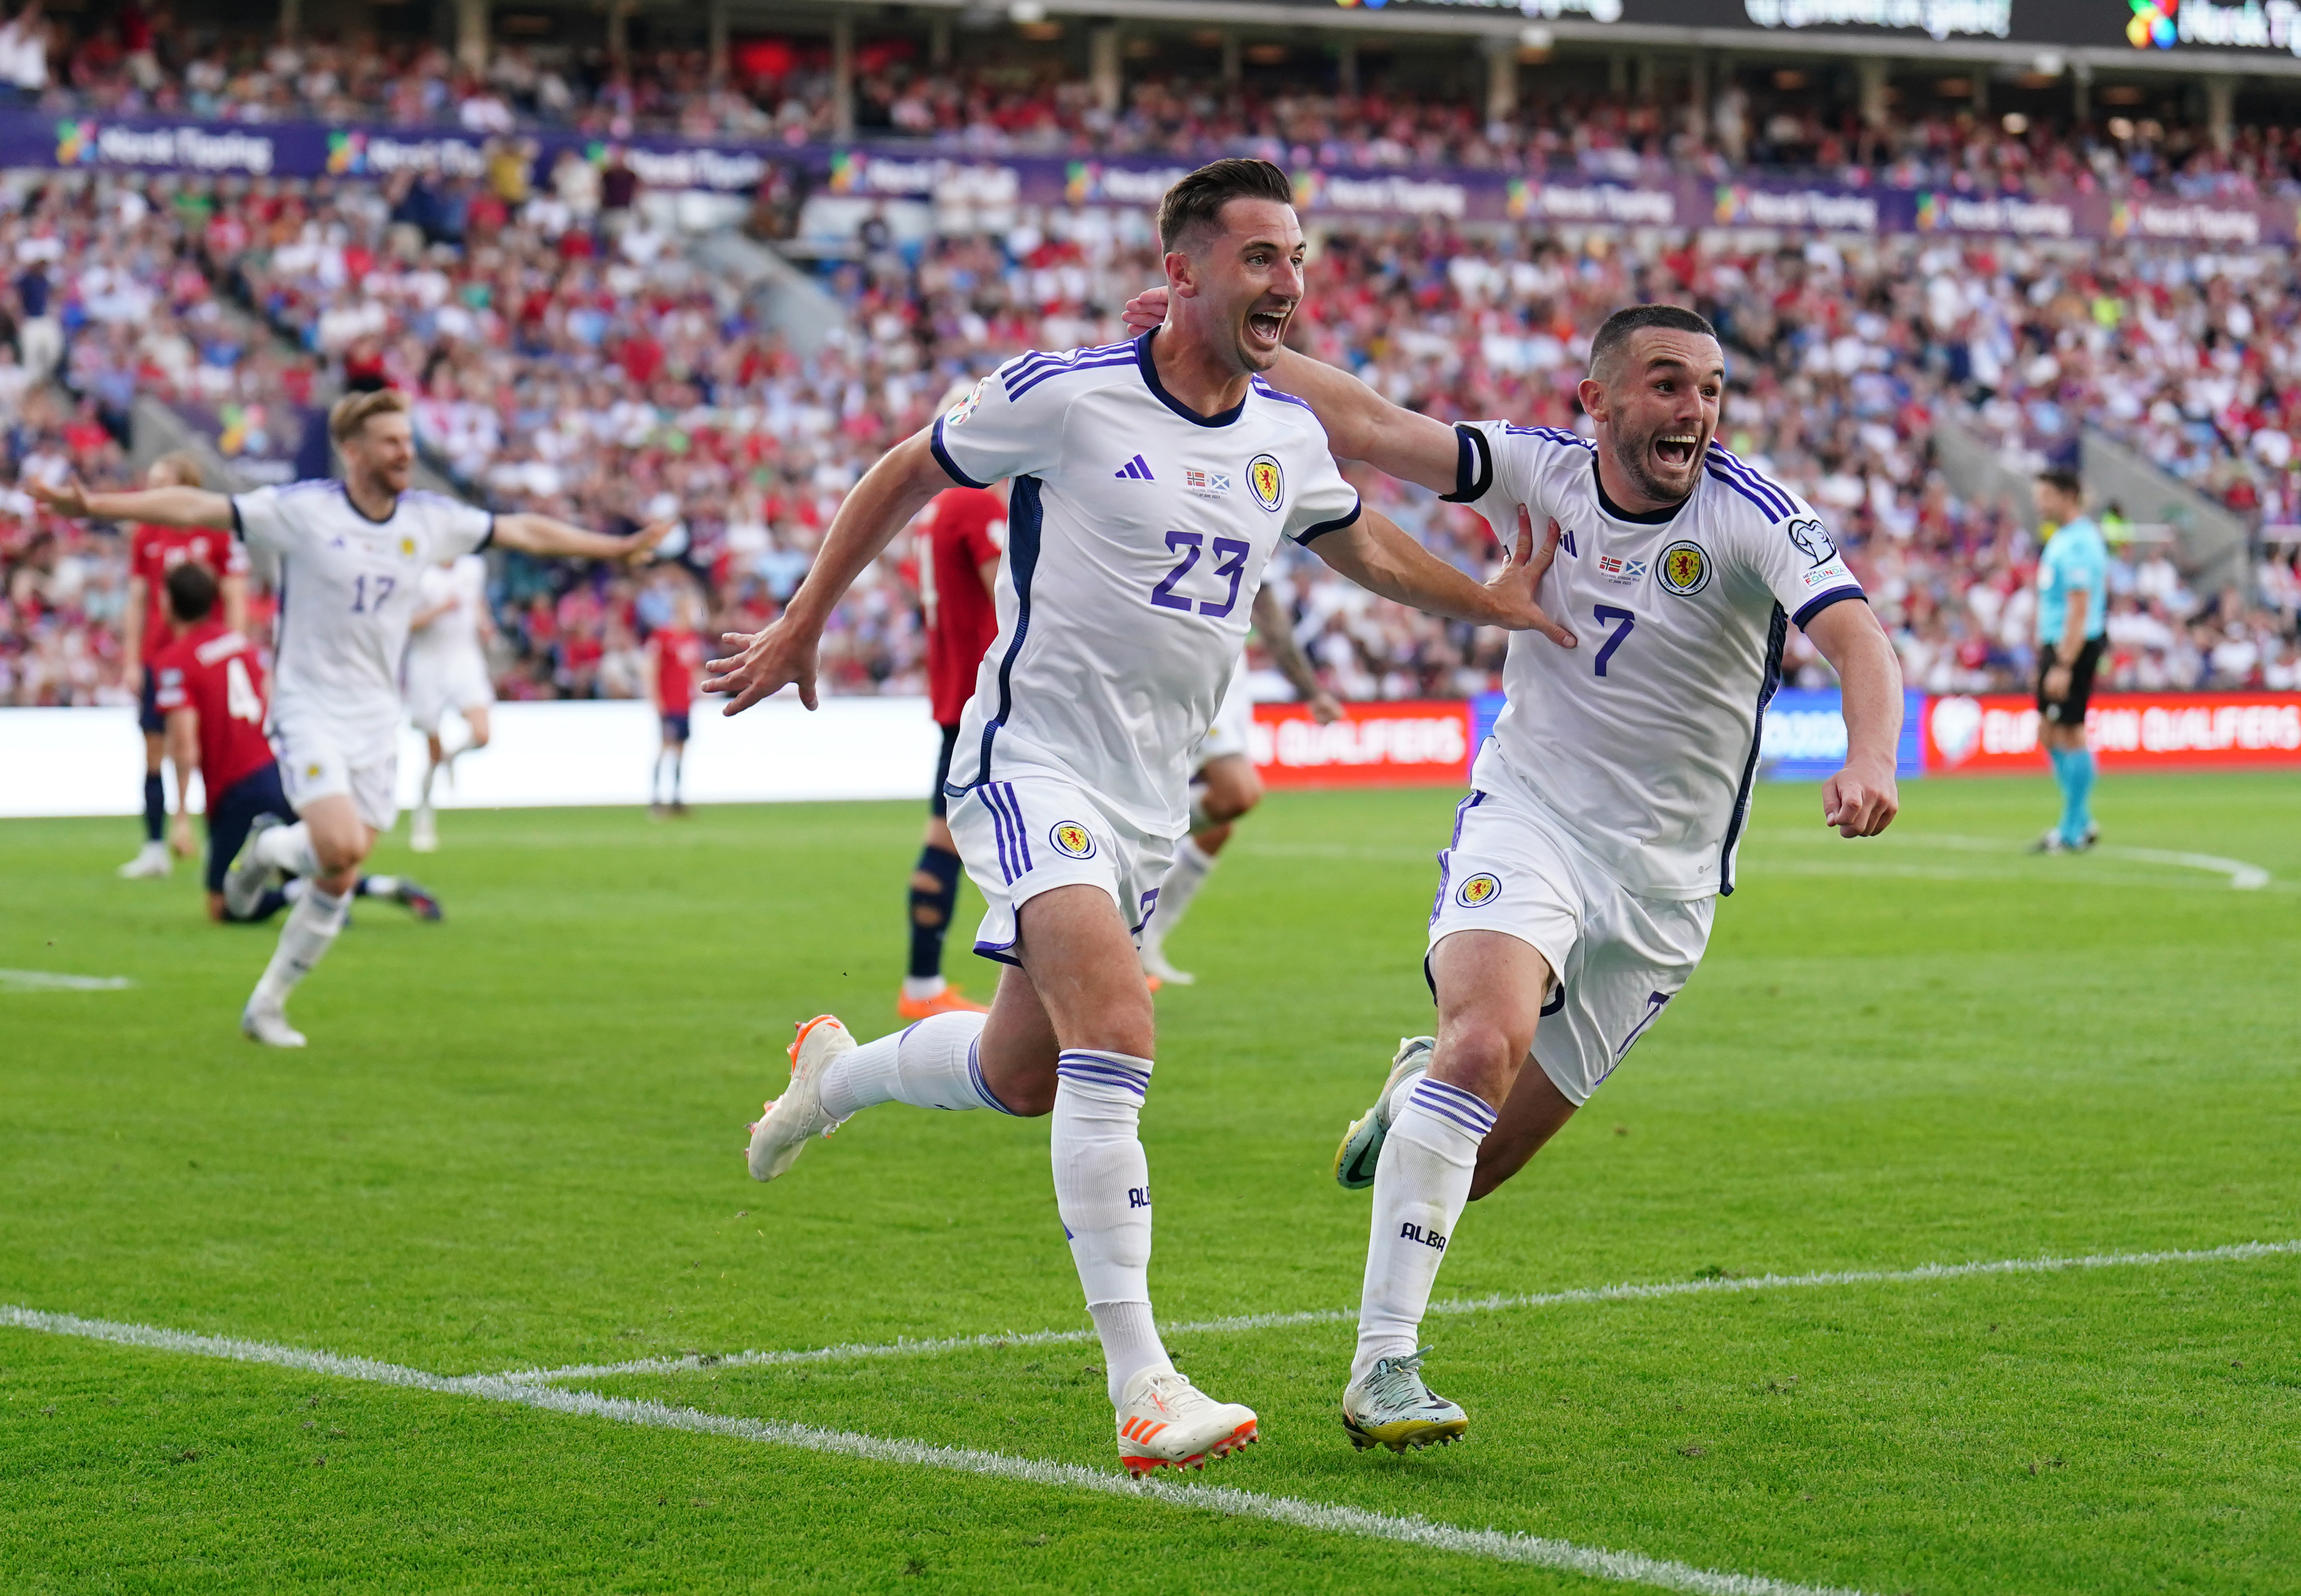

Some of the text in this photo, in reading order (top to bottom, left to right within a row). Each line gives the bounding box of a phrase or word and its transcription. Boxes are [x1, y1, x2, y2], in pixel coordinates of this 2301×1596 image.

[351, 573, 395, 615] 17
[1150, 531, 1250, 618] 23
[1803, 571, 1817, 579] UEFA
[1805, 568, 1846, 585] FOUNDA
[1593, 604, 1636, 677] 7
[227, 657, 262, 725] 4
[1400, 1222, 1446, 1252] ALBA
